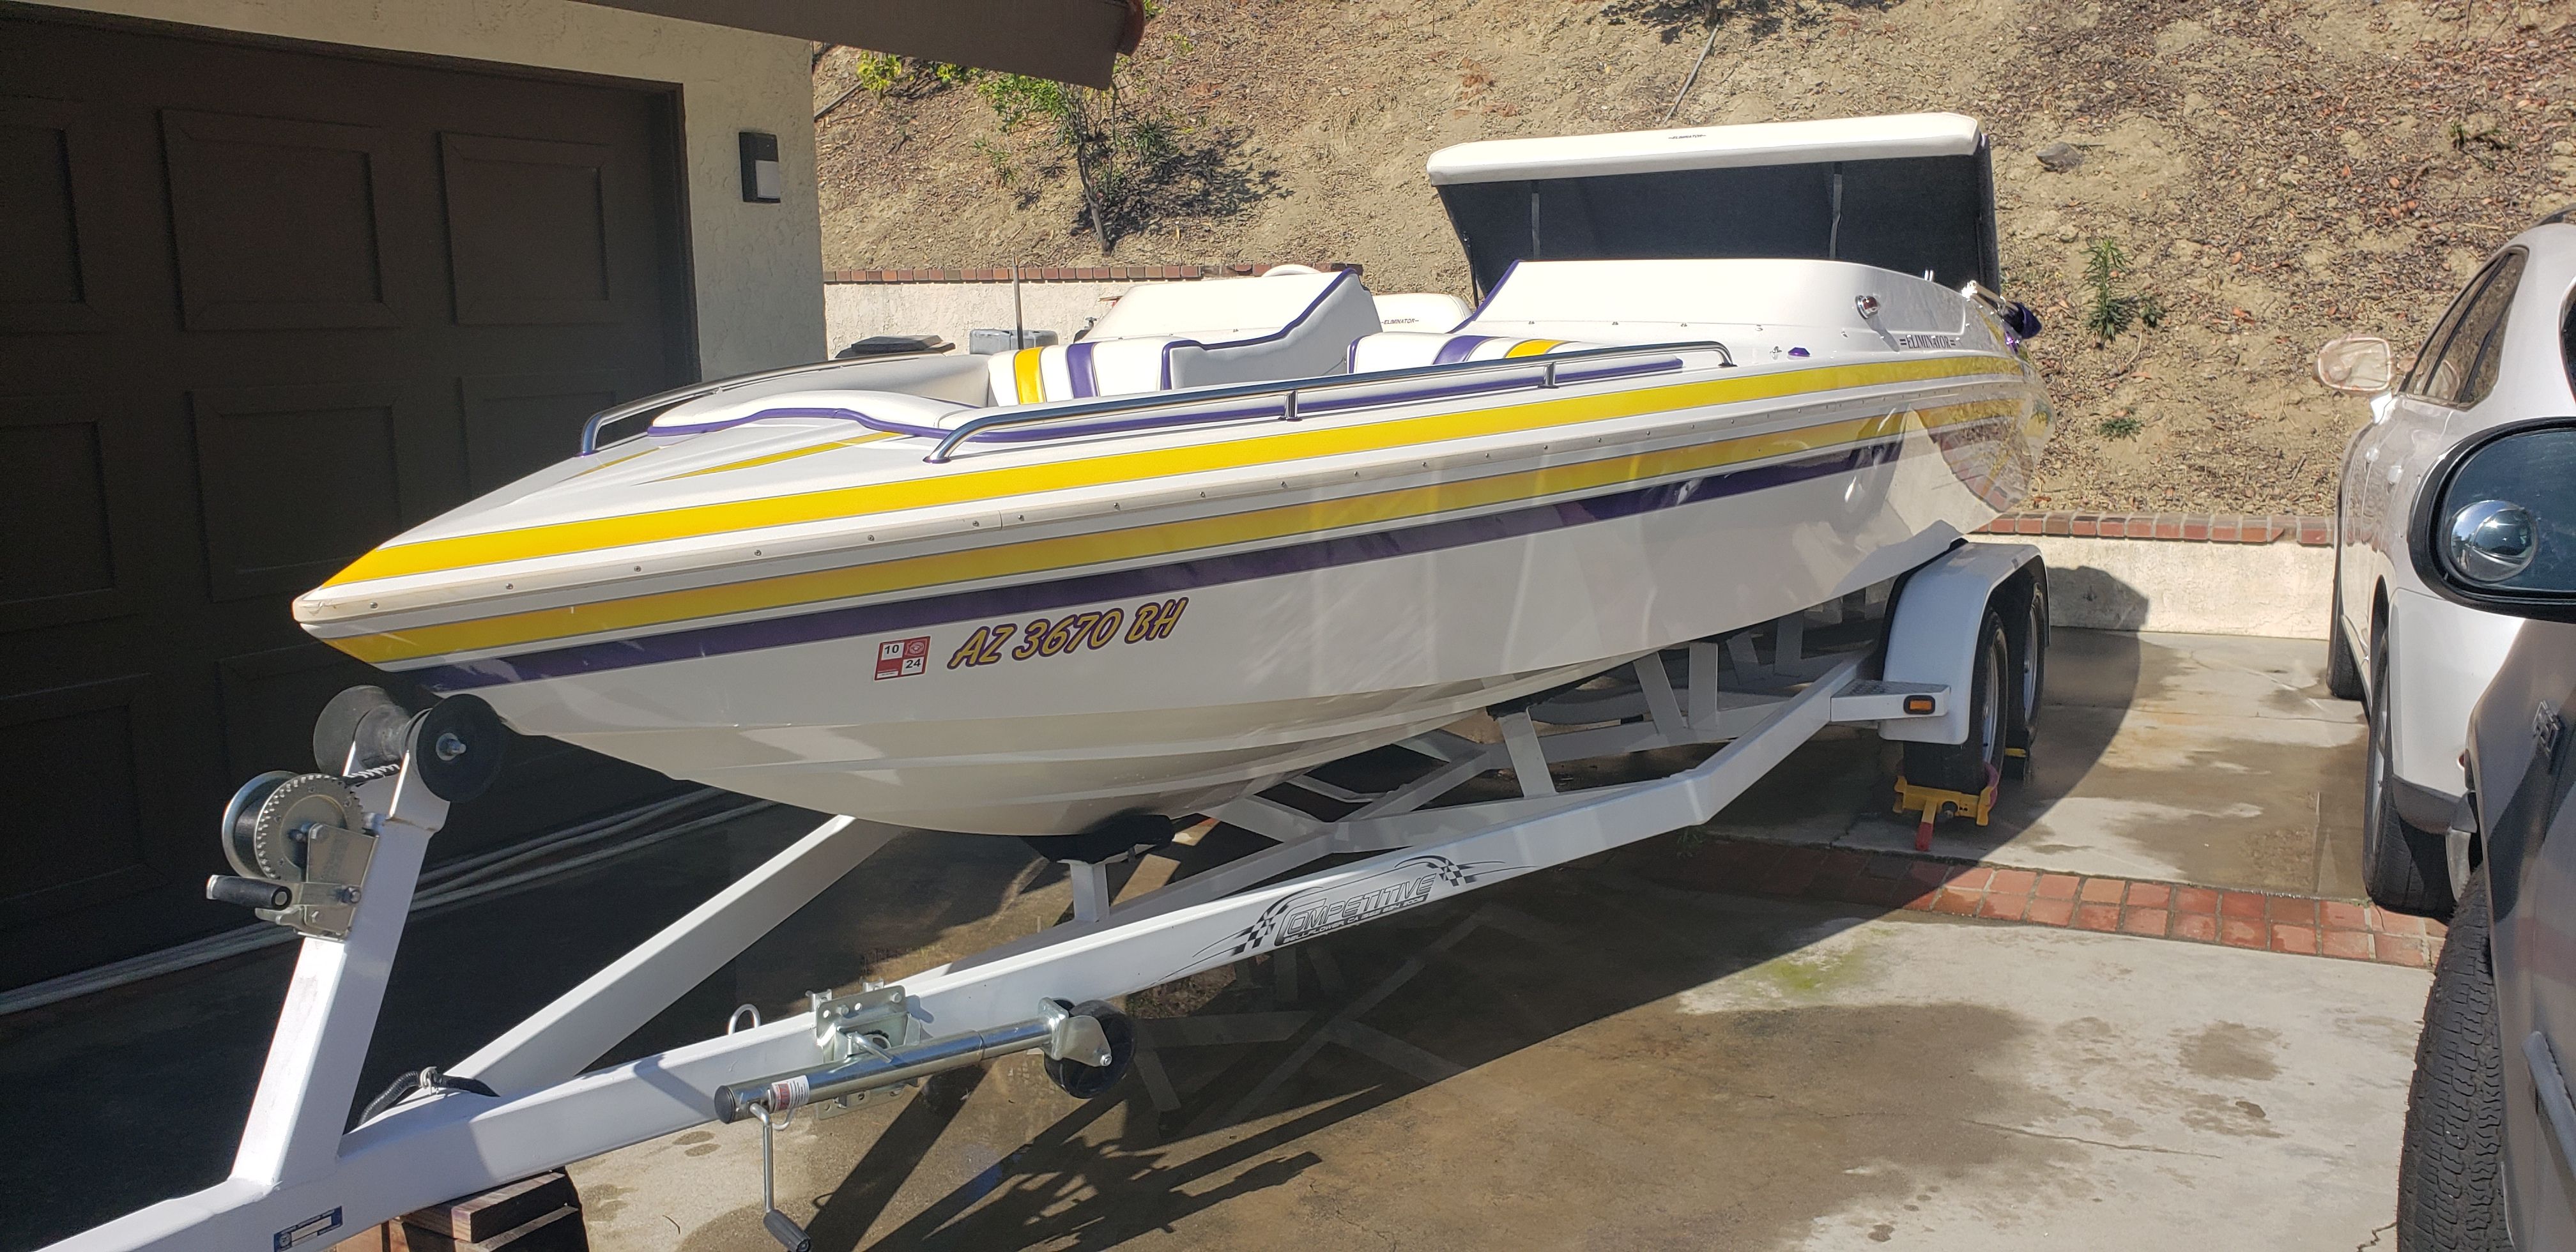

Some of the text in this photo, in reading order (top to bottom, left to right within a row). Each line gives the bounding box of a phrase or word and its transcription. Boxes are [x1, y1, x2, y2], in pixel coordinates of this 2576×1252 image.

[1906, 335, 1952, 349] ELIMINATOR
[947, 597, 1189, 669] AZ 3670 BH
[884, 644, 900, 655] 10
[905, 658, 921, 669] 24
[1274, 873, 1437, 946] COMPETITIVE
[1283, 920, 1344, 943] BELLFLOWER
